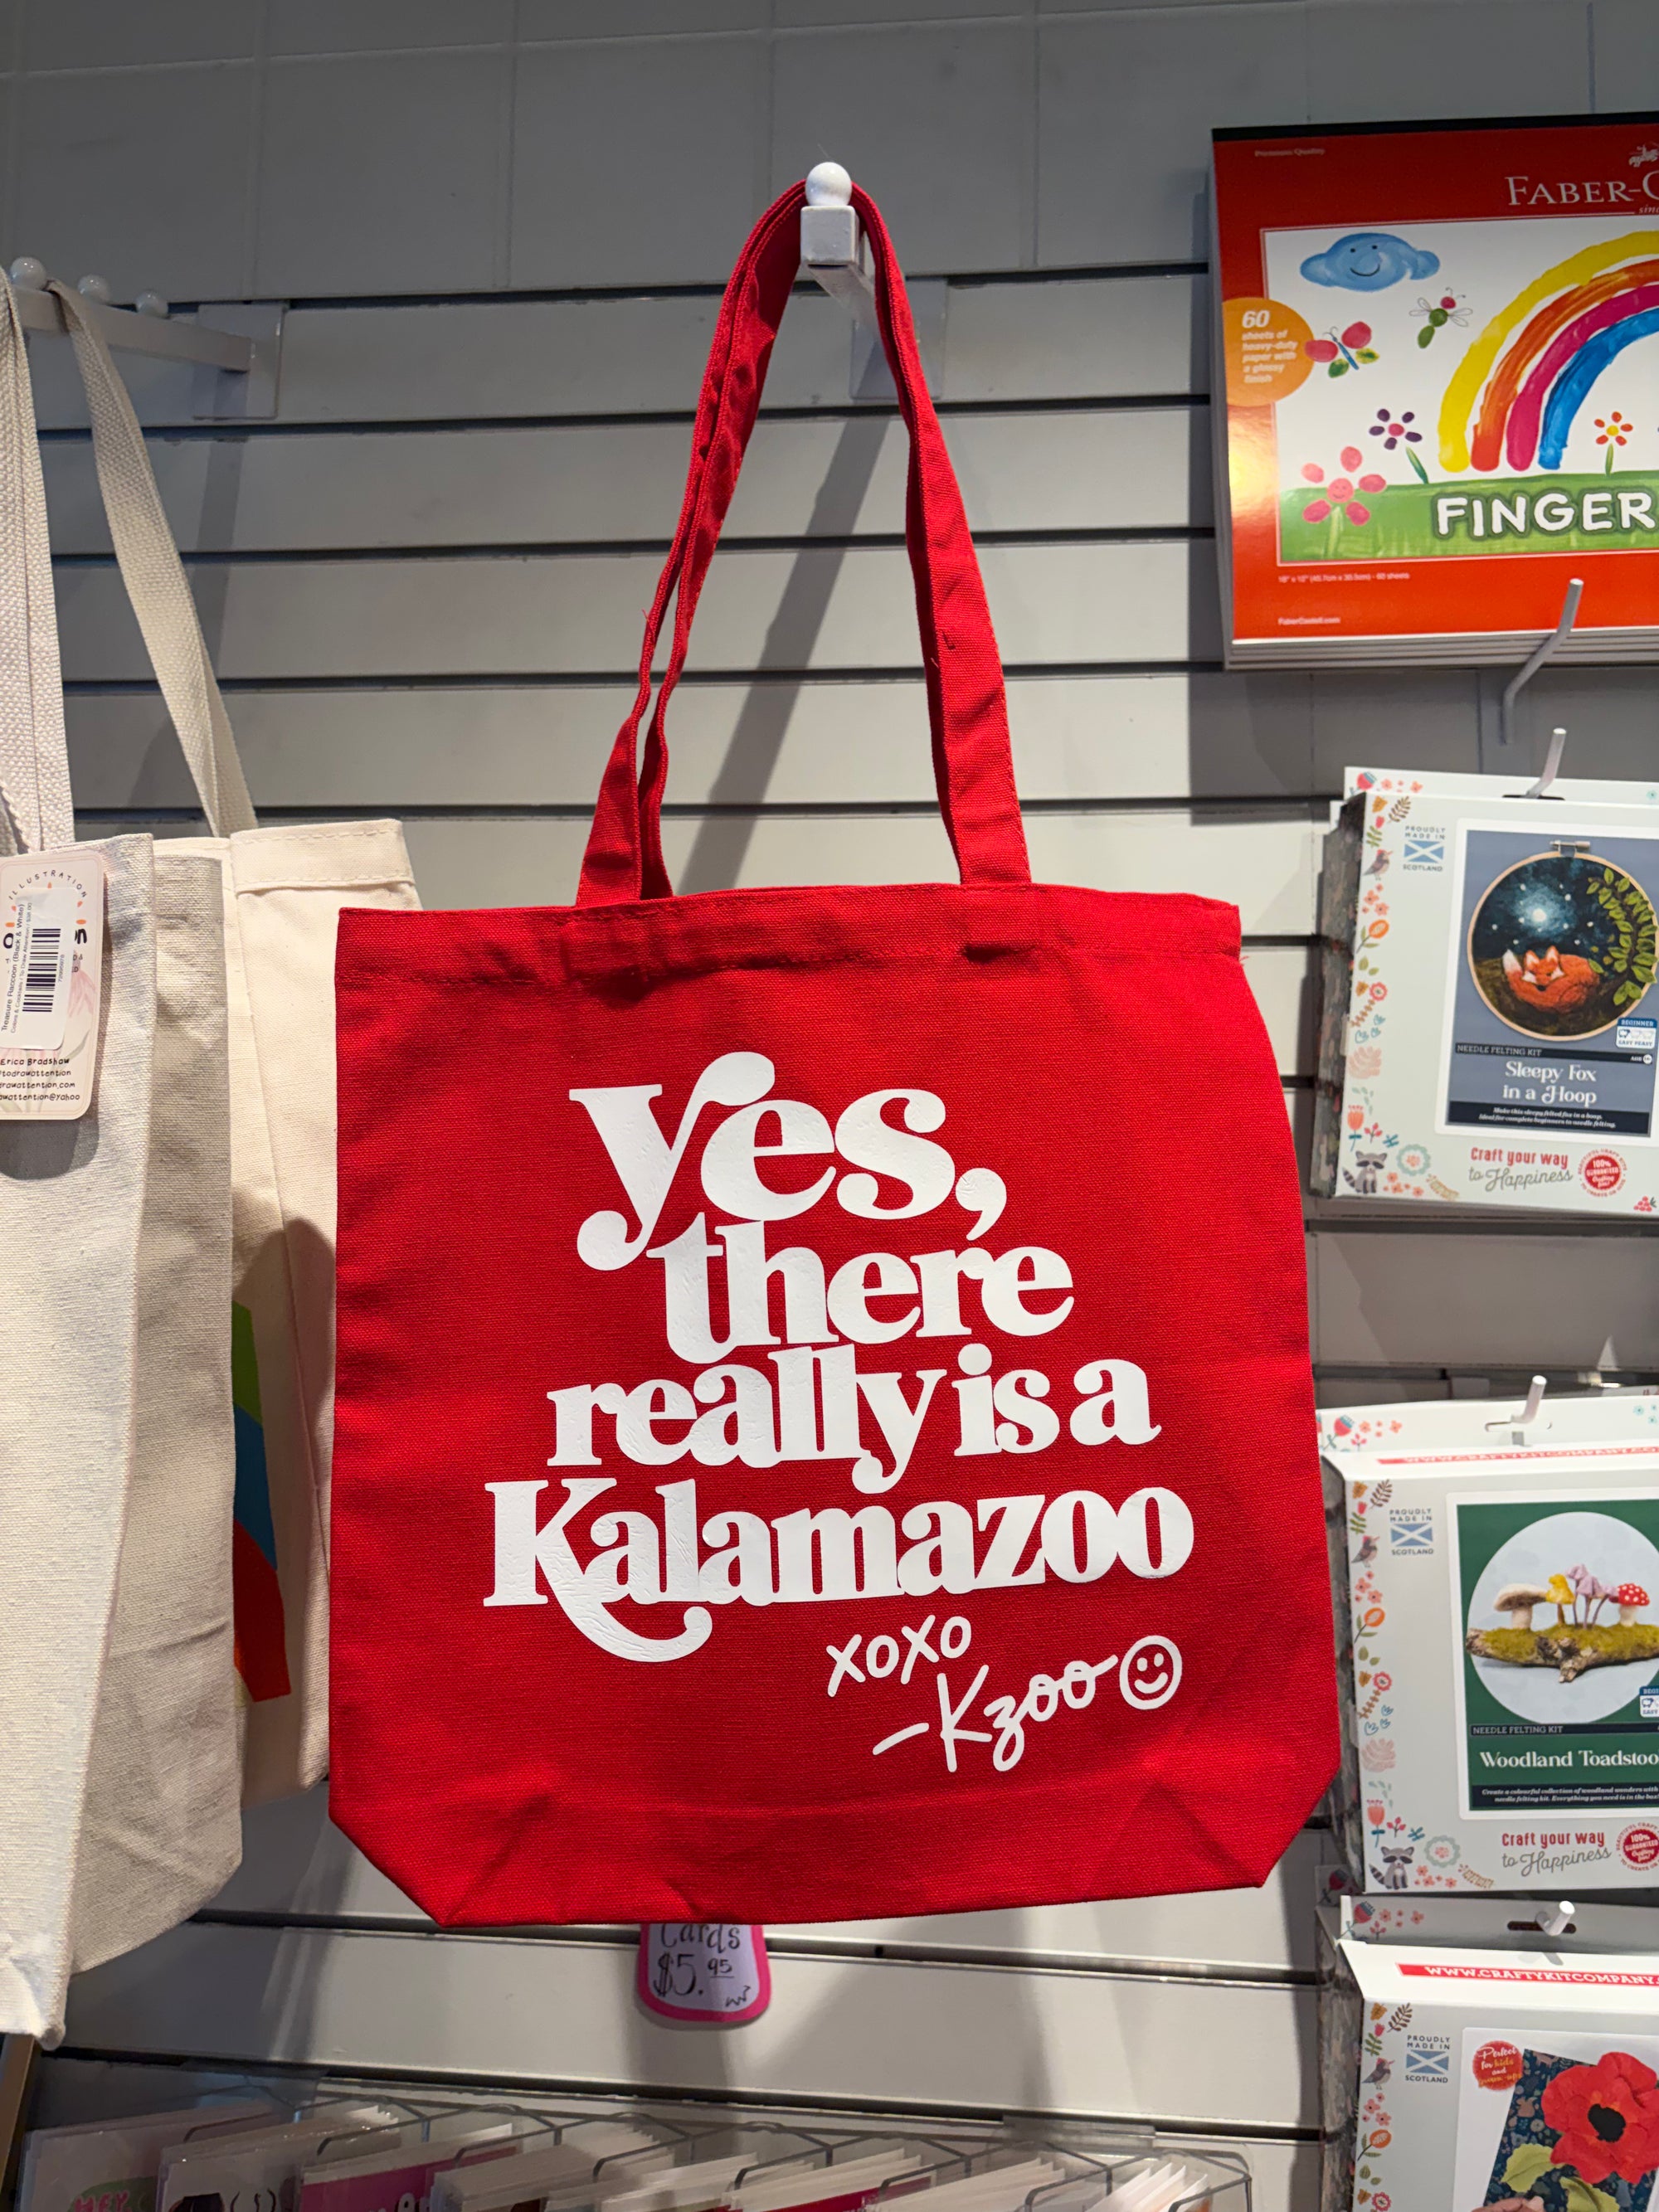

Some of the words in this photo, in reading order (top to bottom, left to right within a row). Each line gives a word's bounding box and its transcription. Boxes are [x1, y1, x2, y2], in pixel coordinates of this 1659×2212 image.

[1241, 309, 1271, 328] 60
[1437, 492, 1657, 537] FINGER
[8, 869, 87, 901] ILLUSTRATION
[17, 903, 26, 929] White)
[12, 941, 22, 965] (Black
[7, 967, 18, 998] Raccoon
[1, 999, 12, 1031] Treasure
[1457, 1044, 1489, 1054] NEEDLE
[1491, 1046, 1525, 1056] FELTING
[1527, 1048, 1542, 1057] KIT
[0, 1057, 25, 1066] Erica
[27, 1057, 70, 1067] Bradshaw
[0, 1069, 72, 1077] todrawattention
[1506, 1061, 1564, 1084] Sleepy
[1569, 1064, 1597, 1082] Fox
[1502, 1085, 1521, 1100] in
[1525, 1088, 1536, 1101] a
[1541, 1085, 1598, 1107] Hoop
[568, 1051, 1008, 1271] yes,
[1471, 1147, 1503, 1163] Craft
[1507, 1150, 1537, 1167] your
[1540, 1153, 1569, 1170] way
[1469, 1166, 1483, 1182] to
[1485, 1166, 1574, 1193] Happiness
[646, 1212, 1075, 1364] there
[546, 1344, 948, 1494] really
[951, 1343, 1060, 1457] is
[1070, 1358, 1162, 1446] a
[1389, 1508, 1432, 1516] PROUDLY
[1391, 1548, 1434, 1556] SCOTLAND
[484, 1476, 1195, 1663] Kalamazoo
[1473, 1726, 1508, 1735] NEEDLE
[1509, 1726, 1547, 1734] FELTING
[1548, 1725, 1564, 1733] KIT
[1480, 1751, 1573, 1767] Woodland
[1578, 1749, 1659, 1767] Toadstoo
[1501, 1832, 1535, 1847] Craft
[1540, 1832, 1571, 1850] your
[1575, 1831, 1605, 1848] way
[1502, 1853, 1518, 1868] to
[1520, 1847, 1613, 1877] Happiness
[1407, 2035, 1451, 2043] PROUDLY
[1477, 2045, 1518, 2060] Perfect
[1481, 2060, 1493, 2070] for
[1405, 2075, 1449, 2083] SCOTLAND
